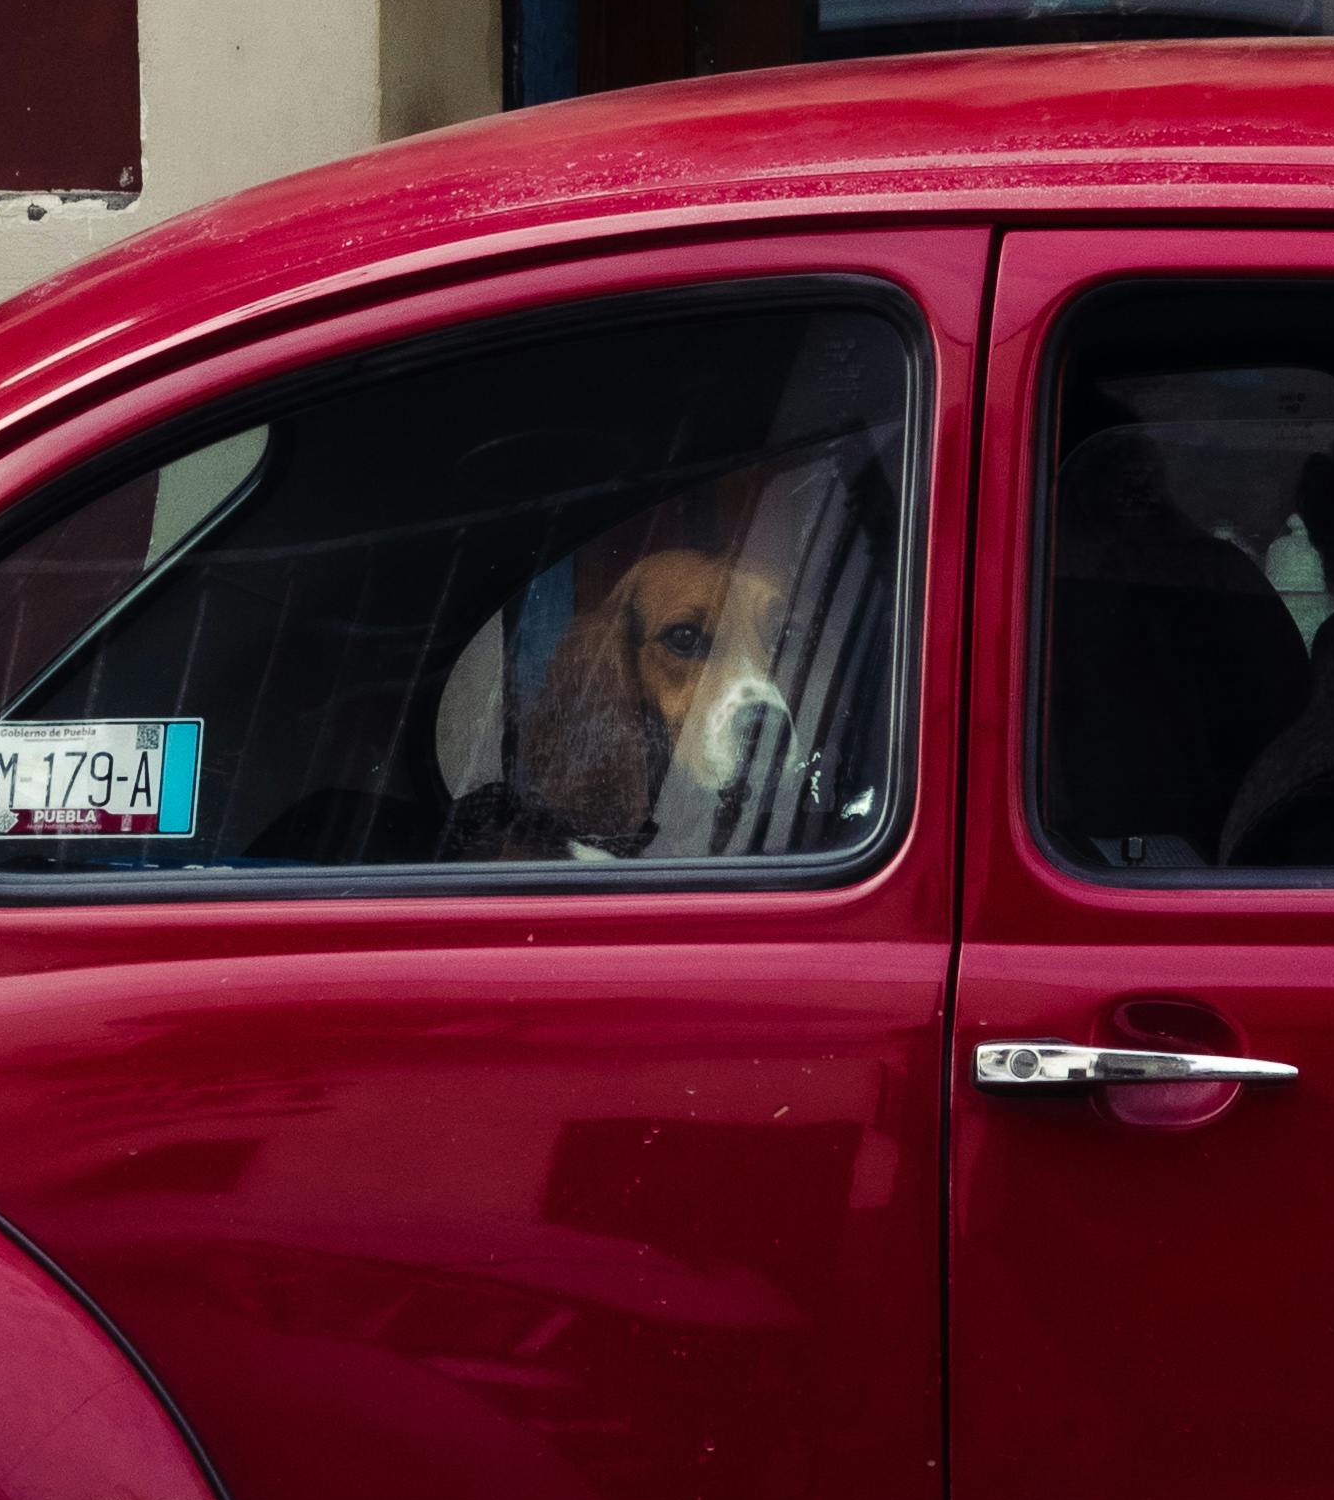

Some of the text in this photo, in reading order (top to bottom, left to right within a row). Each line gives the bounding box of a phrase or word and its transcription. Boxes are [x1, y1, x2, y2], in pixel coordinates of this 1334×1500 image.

[0, 726, 97, 738] Gobierno de Puebla
[33, 809, 97, 824] PUEBLA
